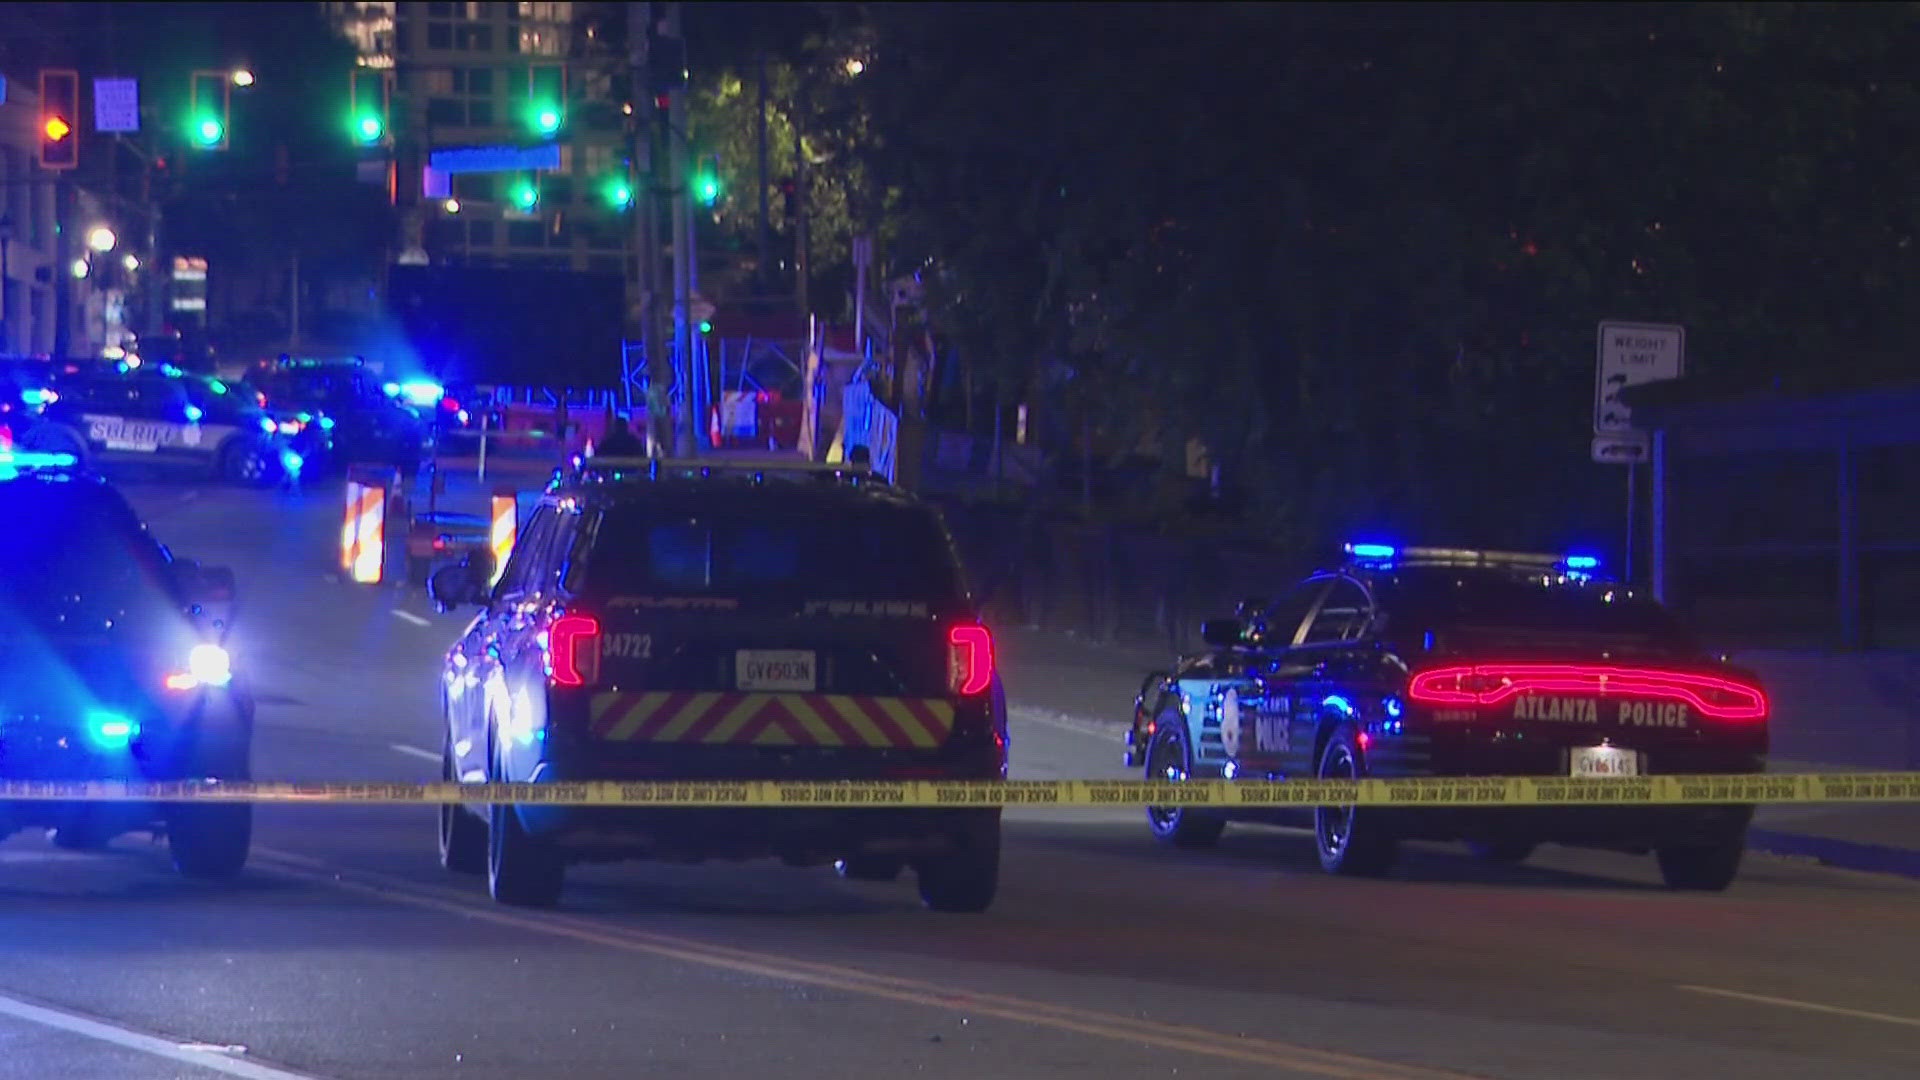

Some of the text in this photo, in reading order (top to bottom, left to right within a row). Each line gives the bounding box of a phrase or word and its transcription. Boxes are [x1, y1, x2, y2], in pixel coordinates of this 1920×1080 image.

[1615, 336, 1666, 352] WEIGHT
[1620, 353, 1657, 366] LIMIT
[602, 632, 651, 658] 34722
[1513, 696, 1688, 728] ATLANTA POLICE
[781, 788, 903, 801] POLICE LINE DO NOT CROSS
[937, 788, 1057, 802] POLICE LINE DO NOT CROSS
[1090, 788, 1209, 802] POLICE LINE DO NOT CROSS
[1241, 787, 1358, 801] POLICE LINE DO NOT CROSS
[1391, 787, 1506, 801] POLICE LINE DO NOT CROSS
